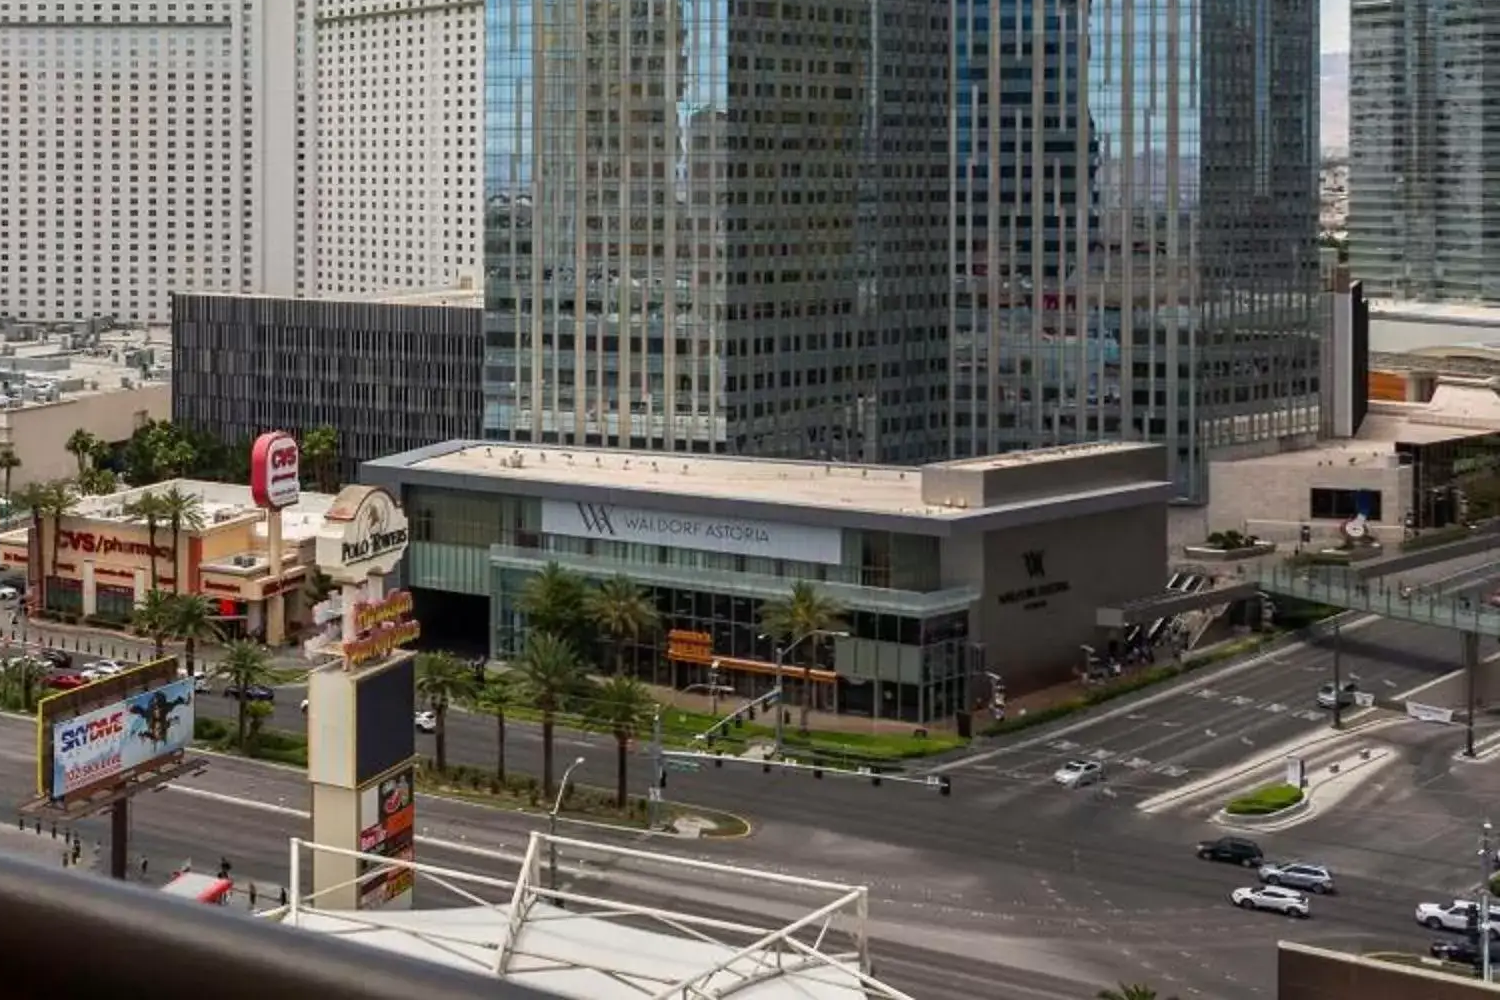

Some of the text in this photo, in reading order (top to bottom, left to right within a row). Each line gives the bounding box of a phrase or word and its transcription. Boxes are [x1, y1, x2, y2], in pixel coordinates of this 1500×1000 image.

[272, 446, 297, 469] CVS
[625, 515, 770, 542] WALDORF ASTORIA
[61, 711, 123, 752] SKYDIVE
